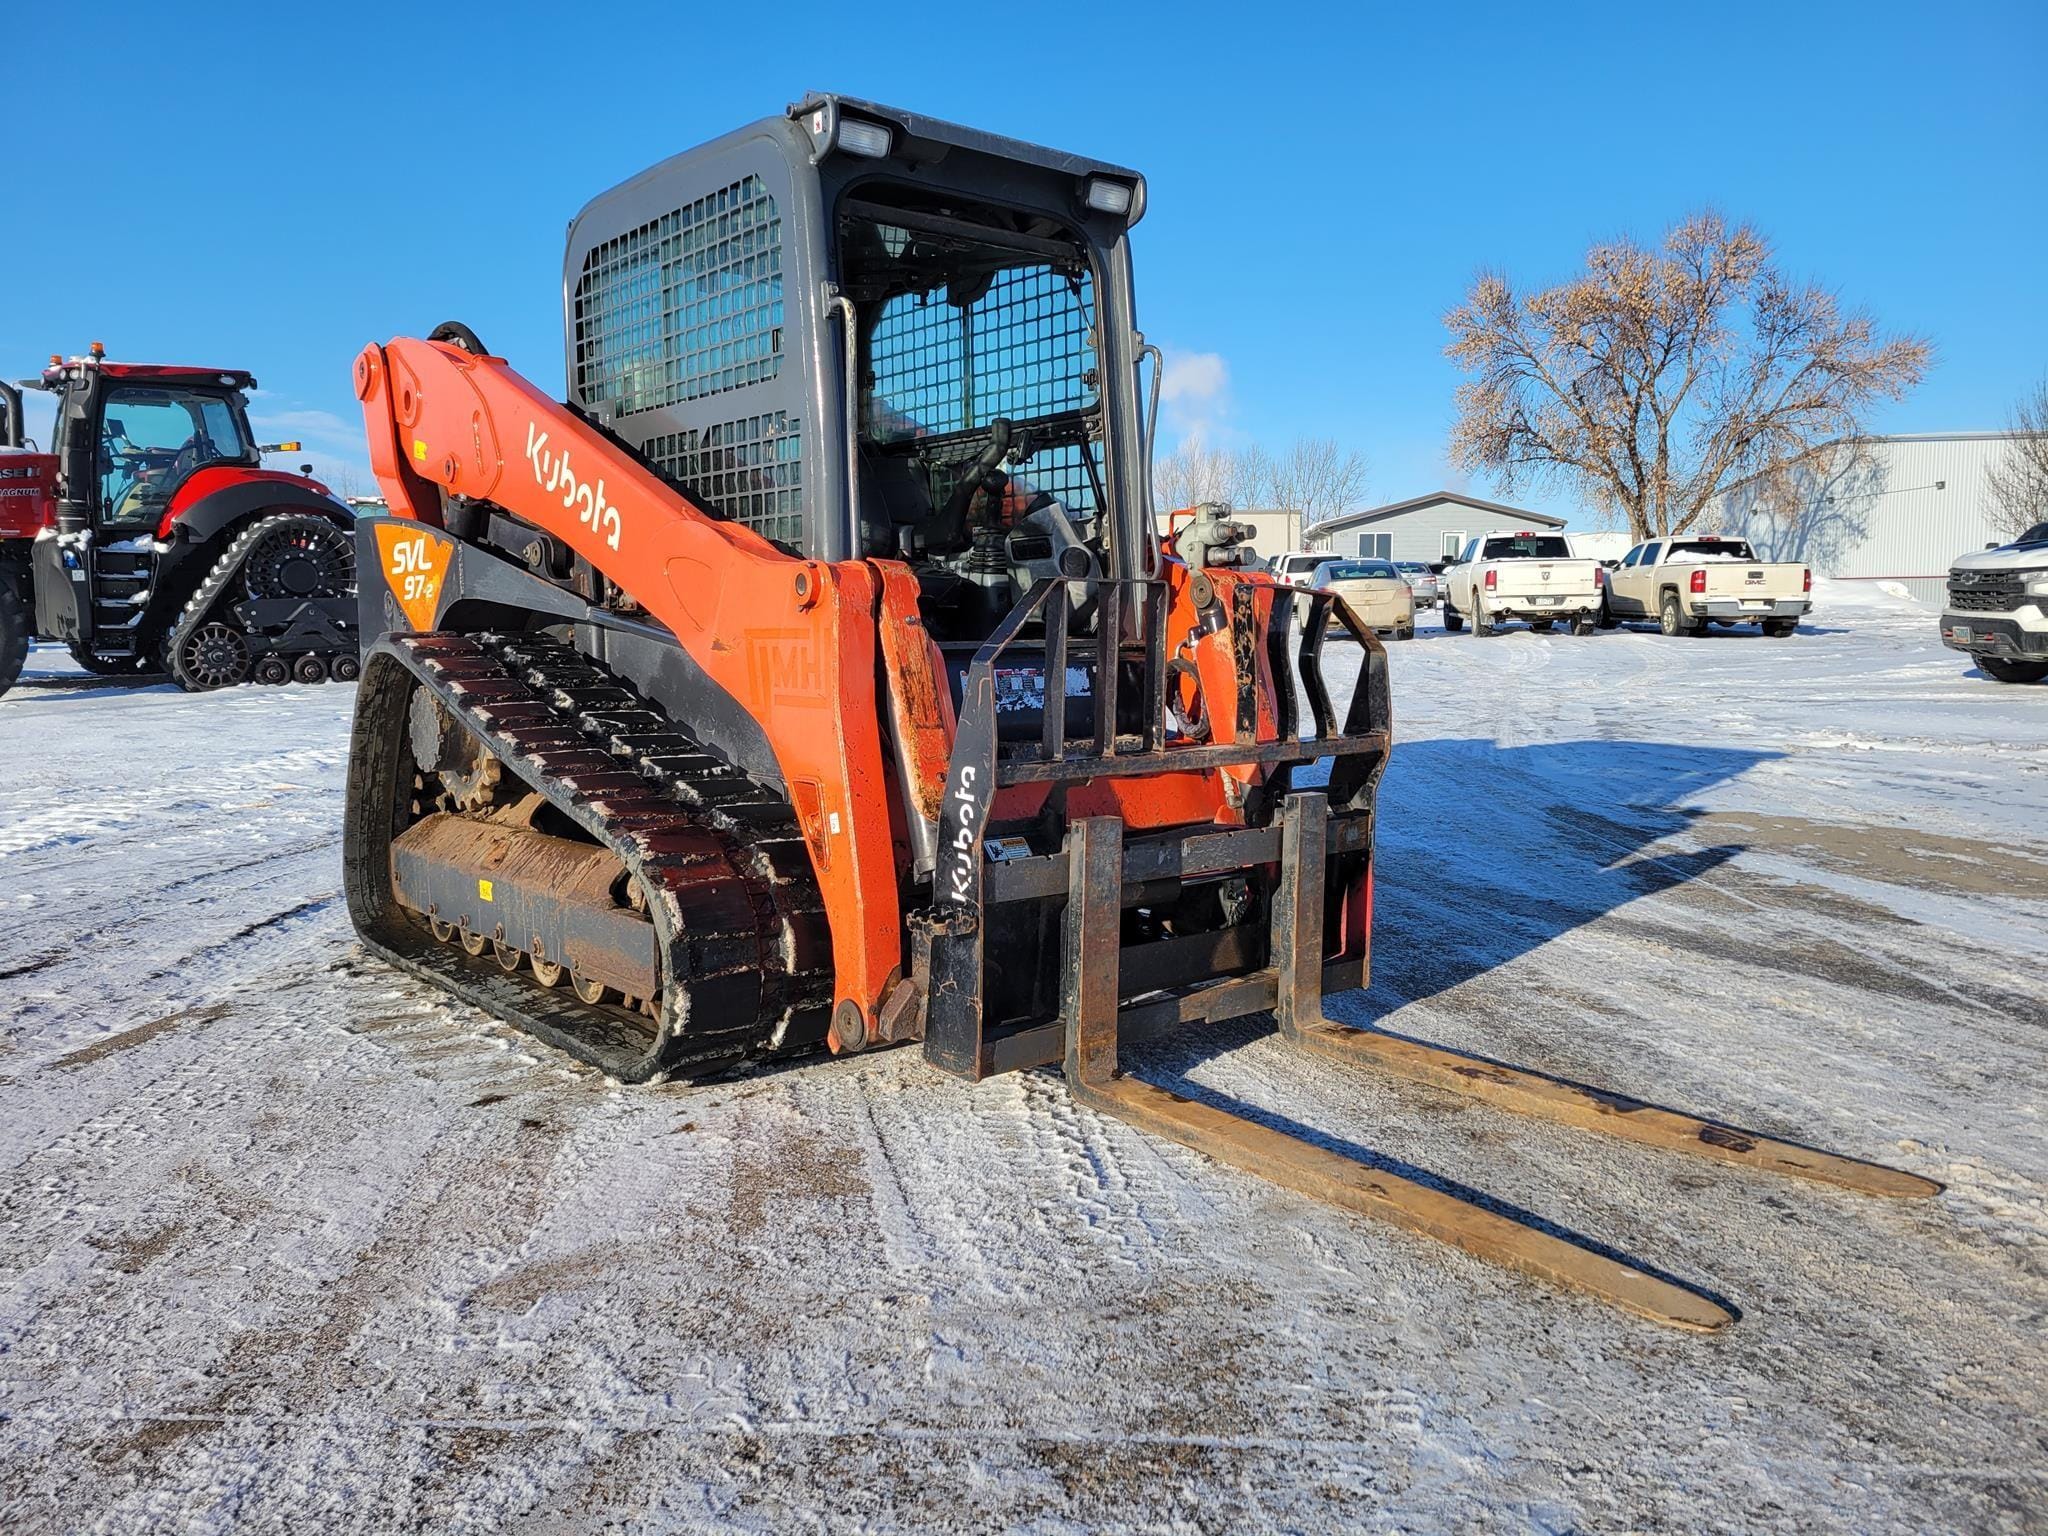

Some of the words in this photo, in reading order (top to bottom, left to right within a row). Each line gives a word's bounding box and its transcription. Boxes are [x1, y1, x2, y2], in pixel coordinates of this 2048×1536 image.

[525, 421, 622, 552] Kubota
[391, 538, 432, 575] SVL
[951, 765, 976, 902] Kubota
